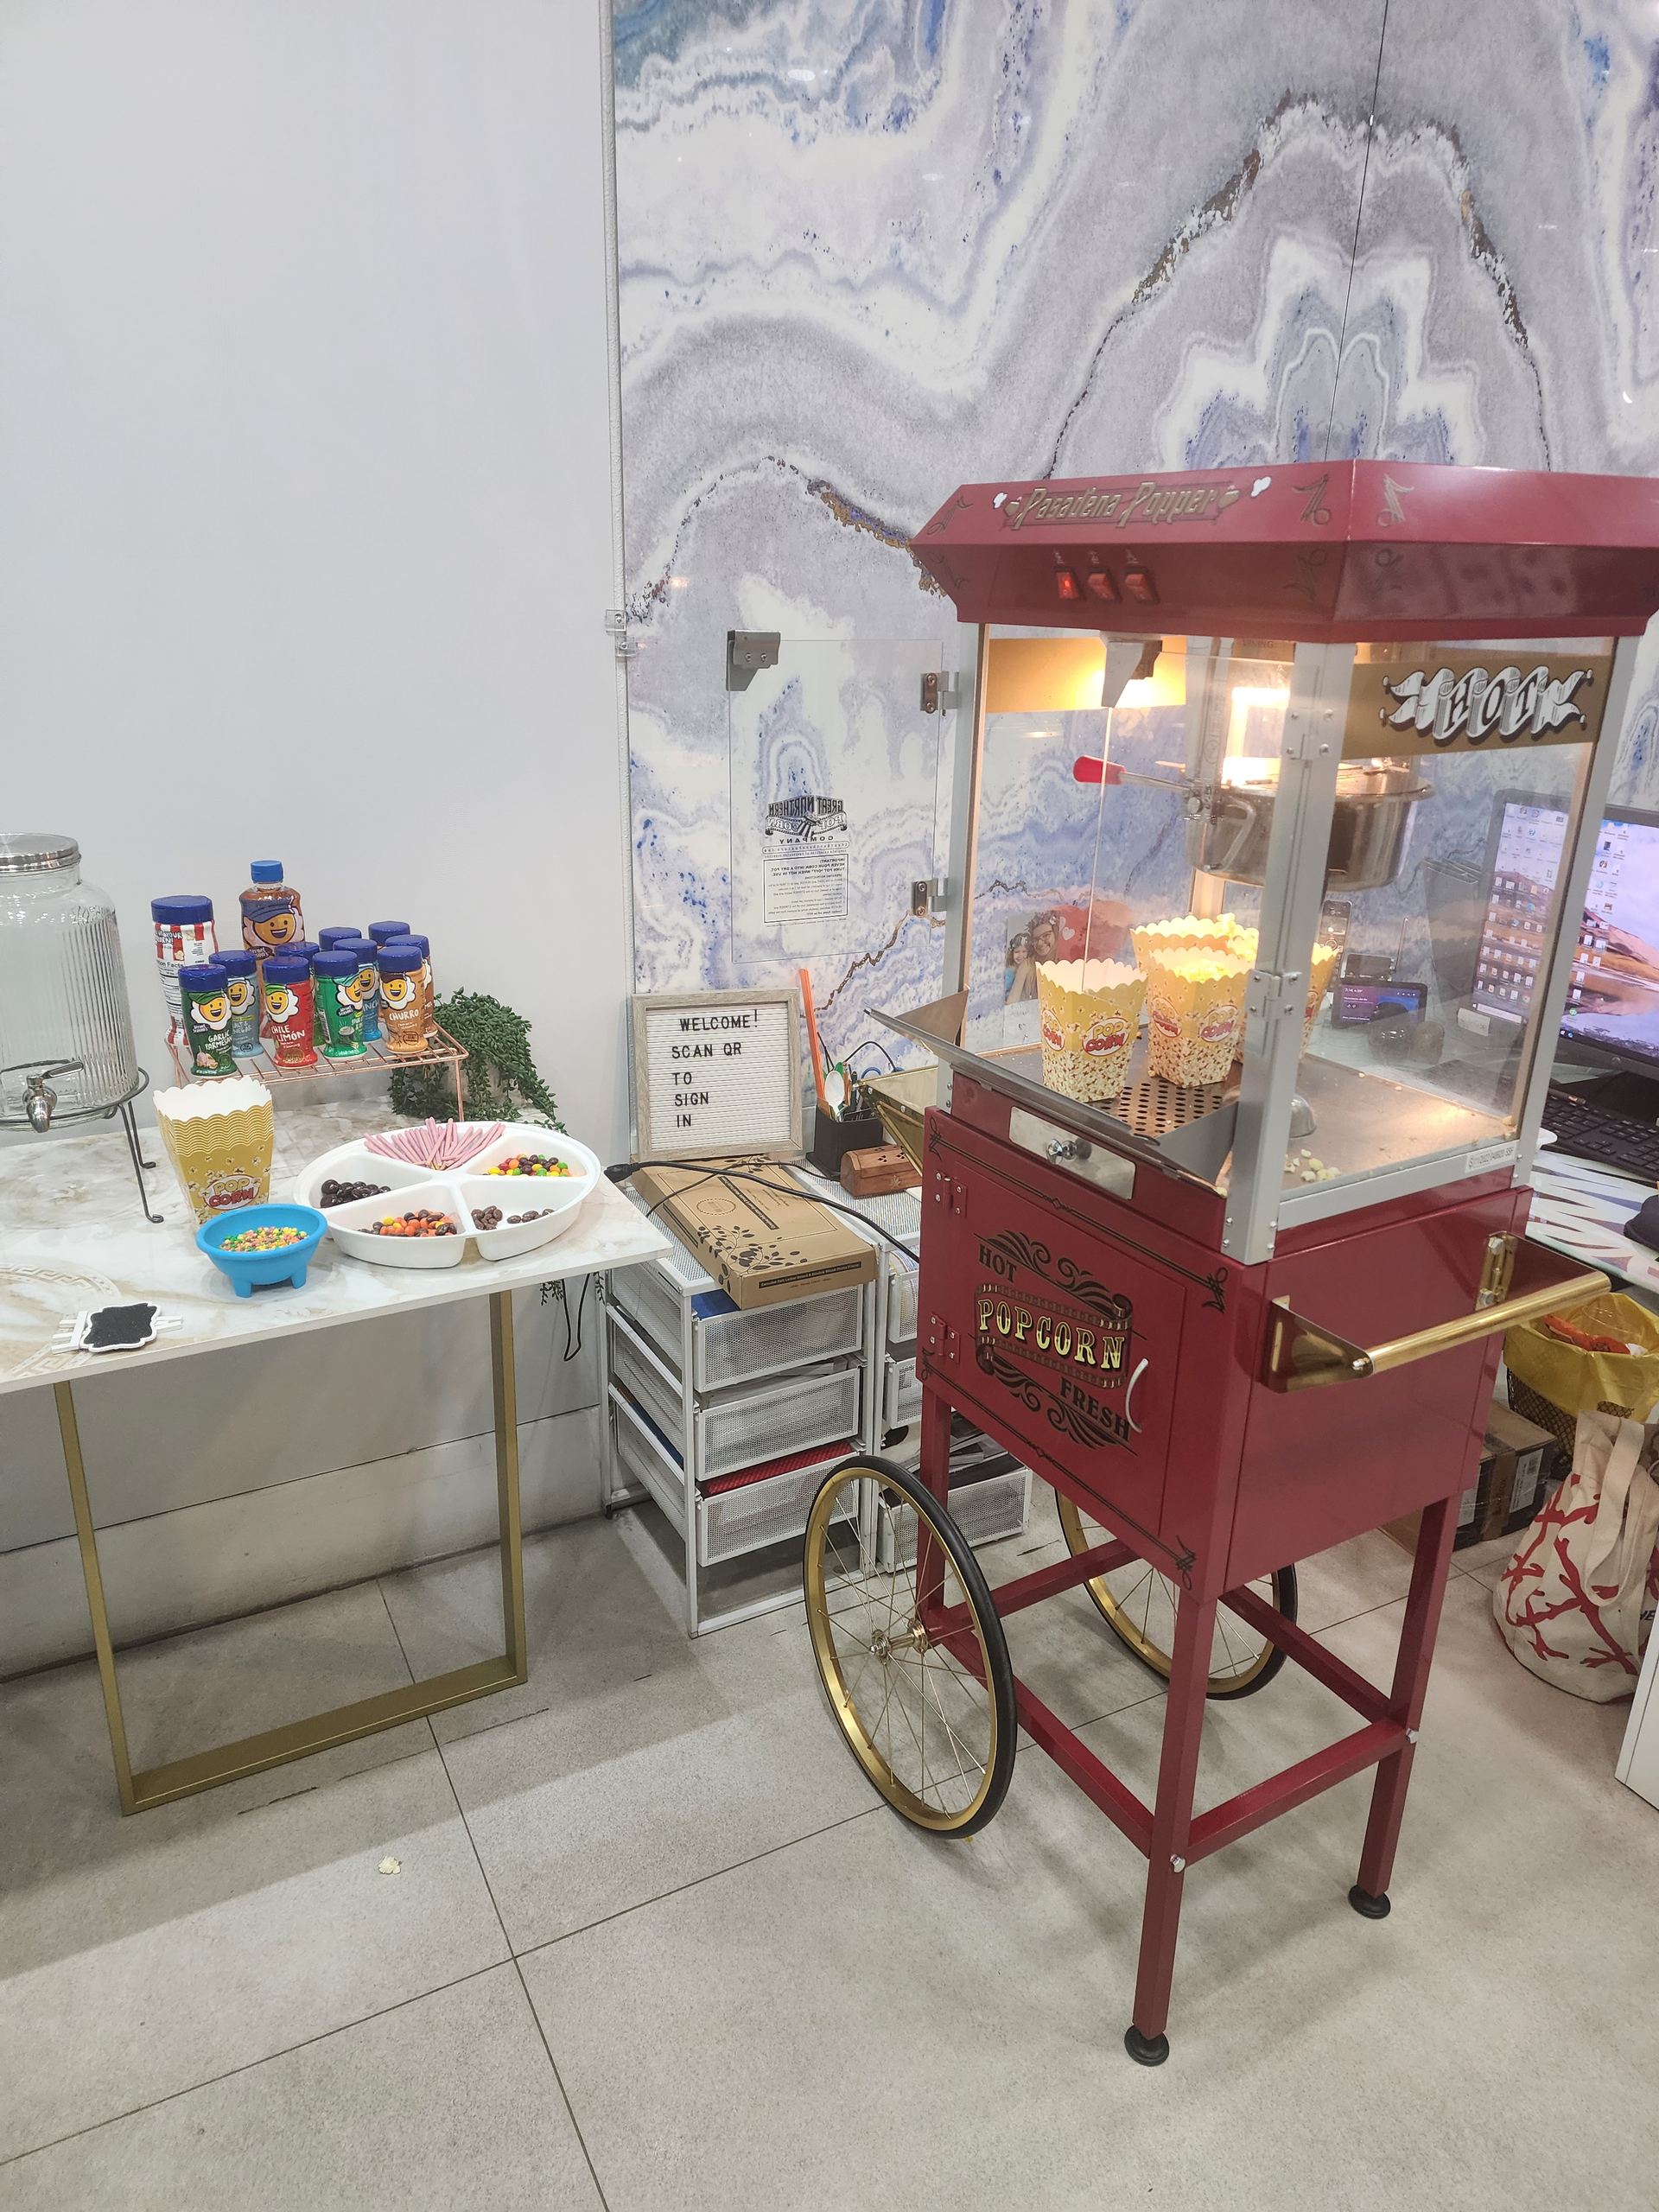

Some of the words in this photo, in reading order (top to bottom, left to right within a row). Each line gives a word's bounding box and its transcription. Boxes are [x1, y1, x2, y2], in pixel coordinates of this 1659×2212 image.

[1011, 487, 1122, 531] Pasadena
[1116, 481, 1217, 529] Popper
[389, 1008, 419, 1021] CHURRO
[680, 1009, 758, 1032] WELCOME!
[1209, 1007, 1235, 1026] POP
[208, 1029, 230, 1043] GARLIC
[271, 1025, 290, 1034] CHILE
[276, 1029, 305, 1043] LIMÓN
[1092, 1021, 1124, 1040] POP
[1201, 1020, 1235, 1038] CORN
[671, 1044, 713, 1059] SCAN
[723, 1042, 741, 1056] QR
[1085, 1032, 1126, 1052] CORN
[672, 1071, 692, 1086] TO
[674, 1091, 709, 1107] SIGN
[677, 1114, 692, 1128] IN
[213, 1178, 251, 1196] POP
[209, 1187, 254, 1207] CORN
[978, 1243, 1017, 1283] HOT
[977, 1299, 1125, 1370] POPCORN
[1059, 1377, 1131, 1443] FRESH
